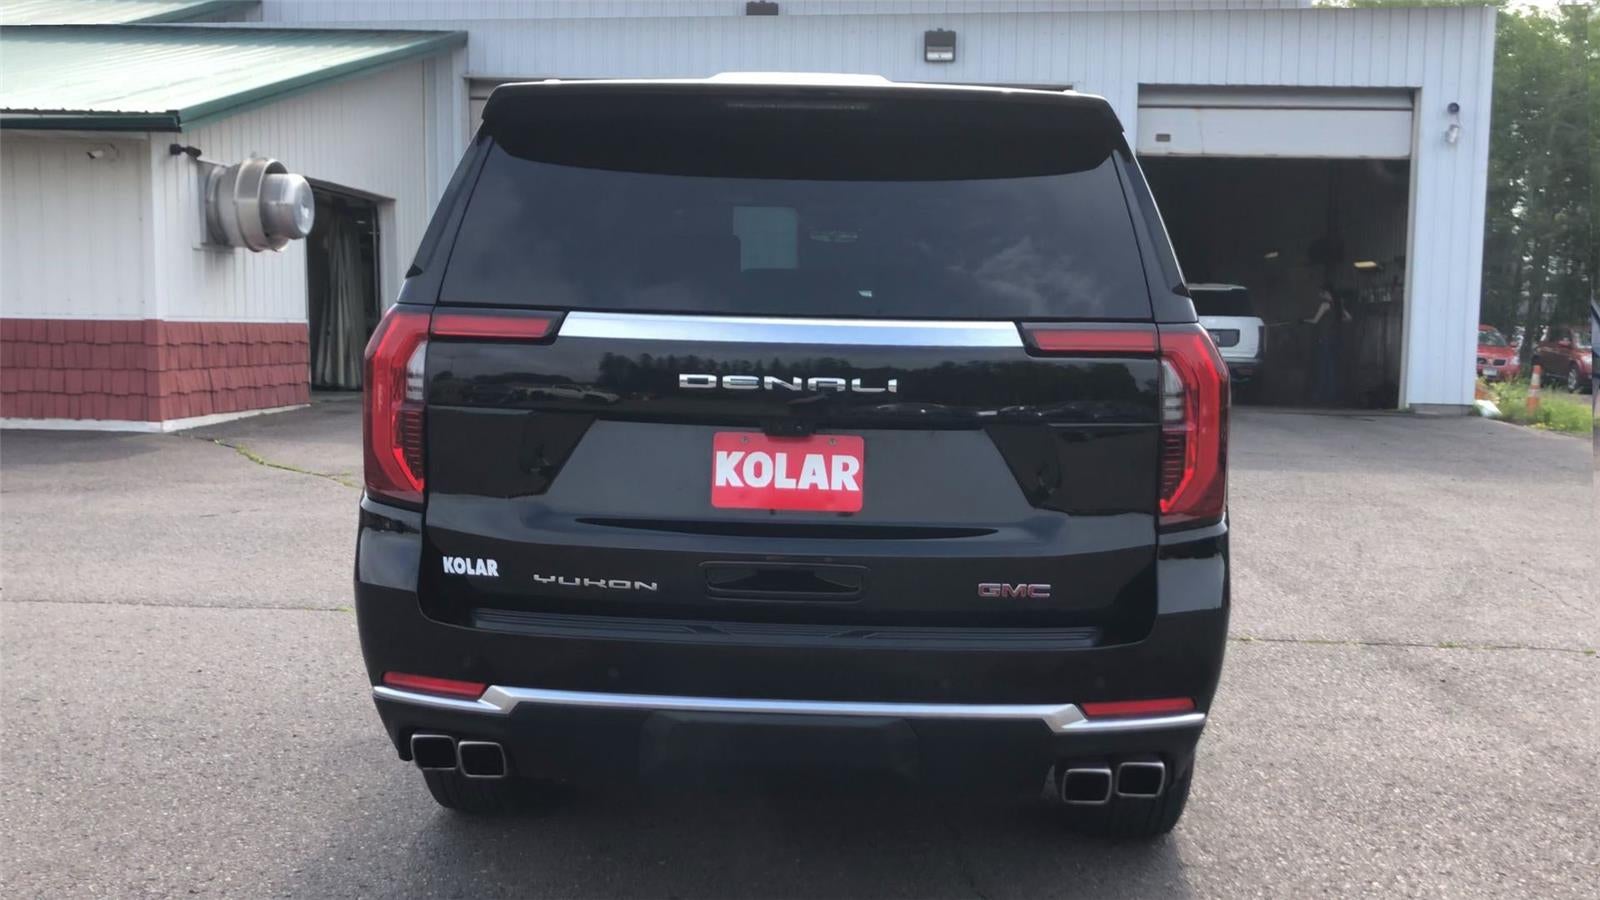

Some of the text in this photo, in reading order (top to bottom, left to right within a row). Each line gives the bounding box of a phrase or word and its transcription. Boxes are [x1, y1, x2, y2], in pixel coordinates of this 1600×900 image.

[679, 373, 898, 393] DENALI
[715, 451, 860, 491] KOLAR
[442, 556, 499, 577] KOLAR
[533, 574, 658, 591] YUKON
[978, 583, 1051, 598] GMC
